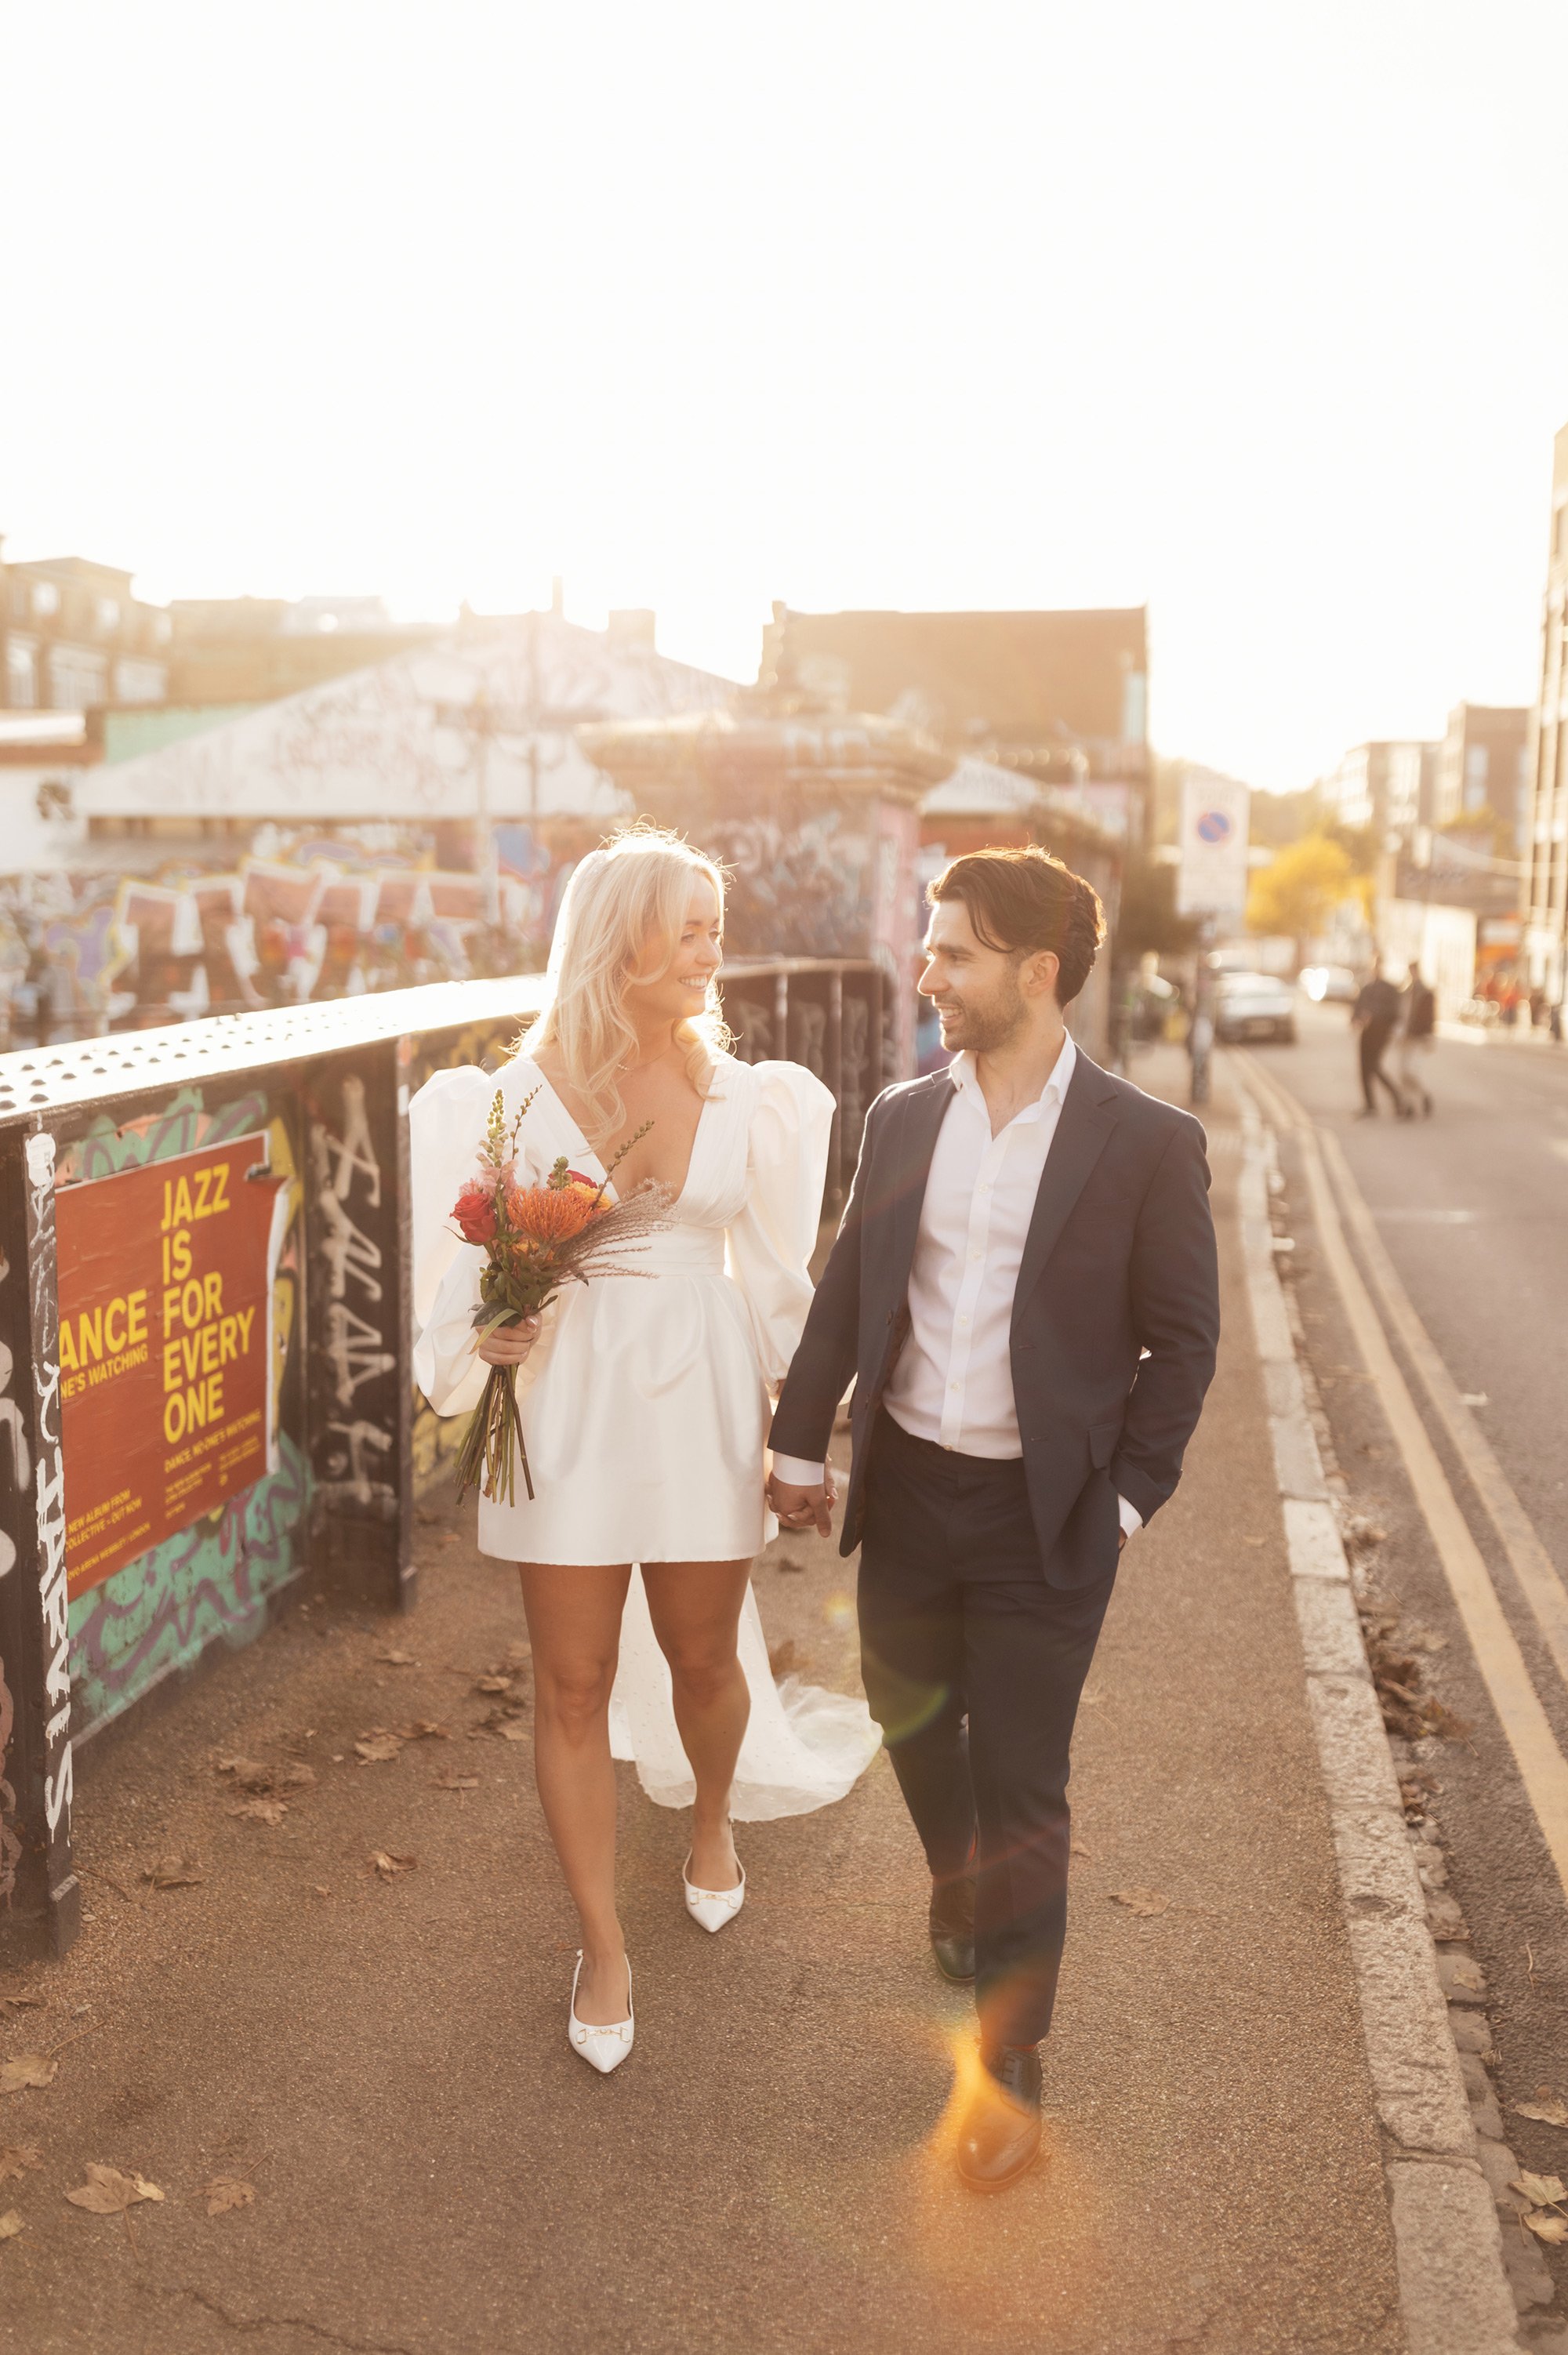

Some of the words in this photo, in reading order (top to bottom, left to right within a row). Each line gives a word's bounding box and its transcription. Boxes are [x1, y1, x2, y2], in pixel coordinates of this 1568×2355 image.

[161, 1162, 230, 1232] JAZZ
[162, 1228, 192, 1286] IS
[59, 1288, 148, 1371] ANCE
[163, 1271, 223, 1340] FOR
[88, 1343, 148, 1386] WATCHING
[163, 1305, 256, 1393] EVERY
[163, 1370, 224, 1444] ONE
[67, 1517, 85, 1536] NEW
[85, 1500, 111, 1524] ALBUM
[111, 1488, 131, 1509] FROM
[111, 1505, 125, 1524] OUT
[125, 1496, 143, 1515] NOW
